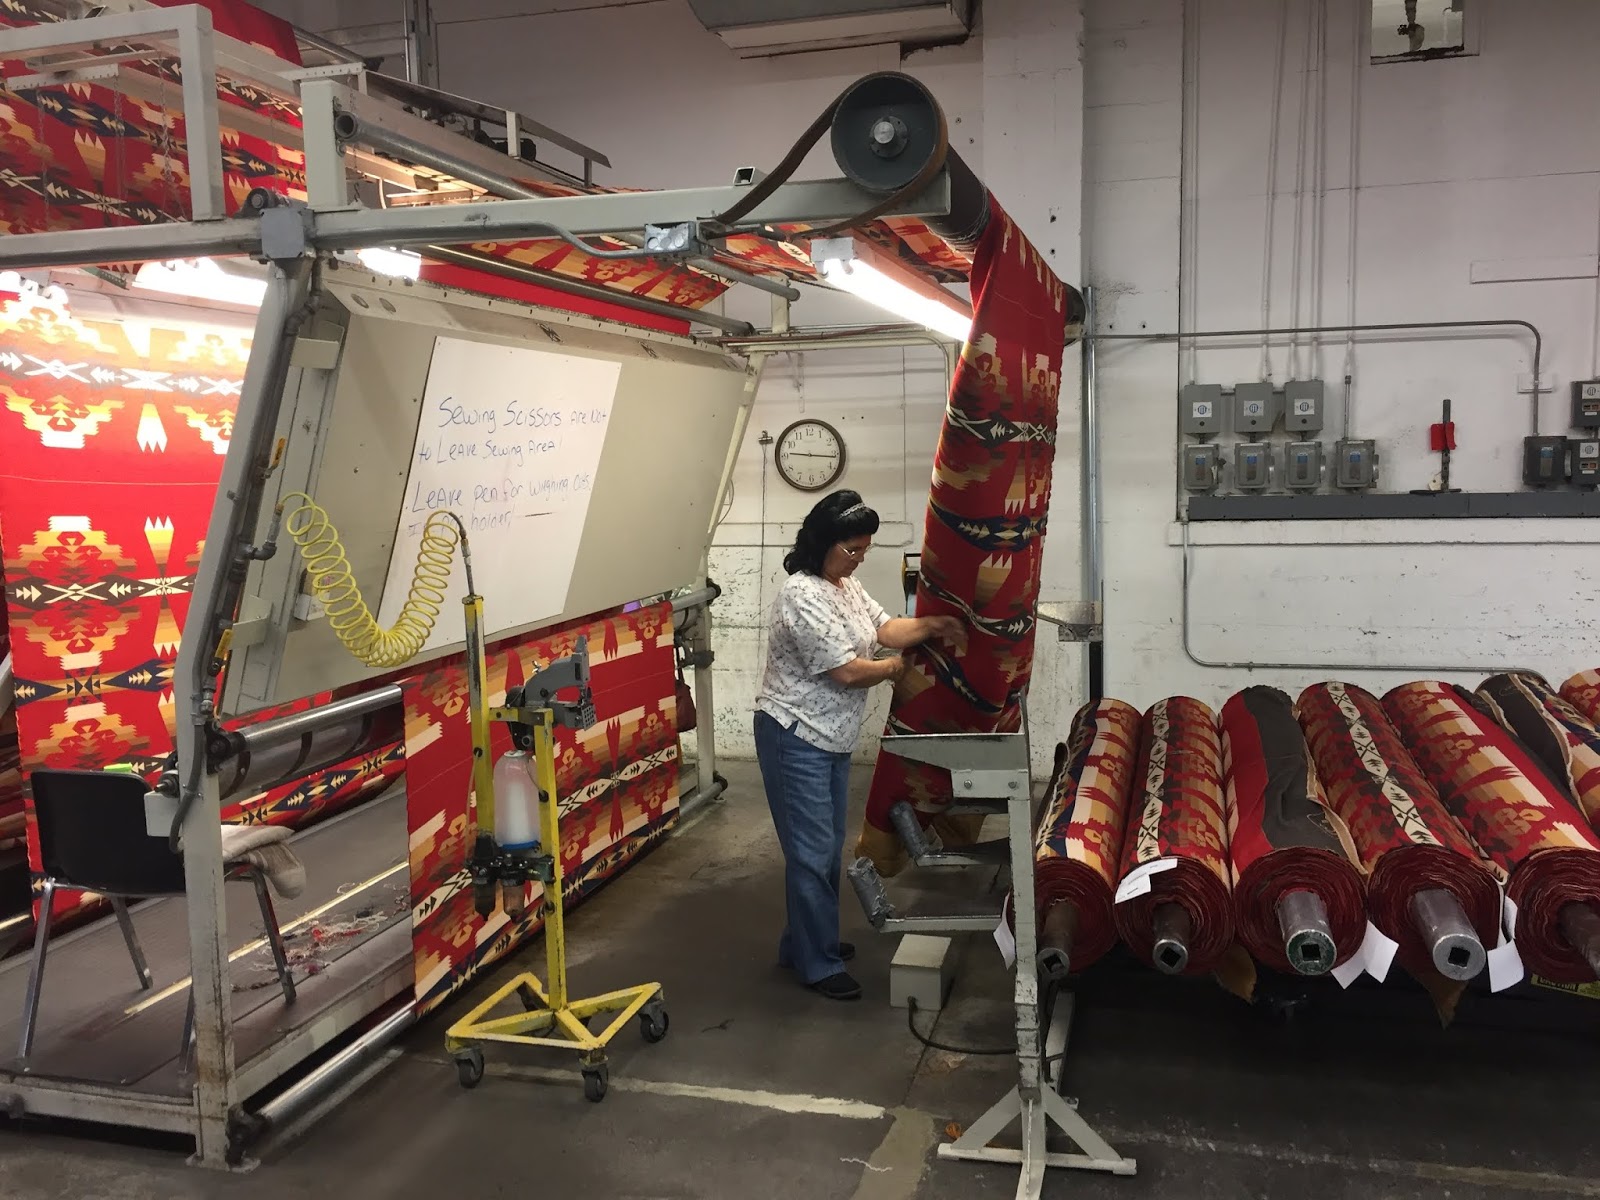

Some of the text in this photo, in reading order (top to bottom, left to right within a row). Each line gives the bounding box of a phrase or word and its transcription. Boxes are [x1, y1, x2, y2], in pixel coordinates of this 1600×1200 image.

[438, 396, 497, 434] Sewing
[502, 400, 562, 428] Scissors
[795, 432, 802, 440] 11
[806, 427, 814, 436] 12
[482, 440, 524, 467] Sewing
